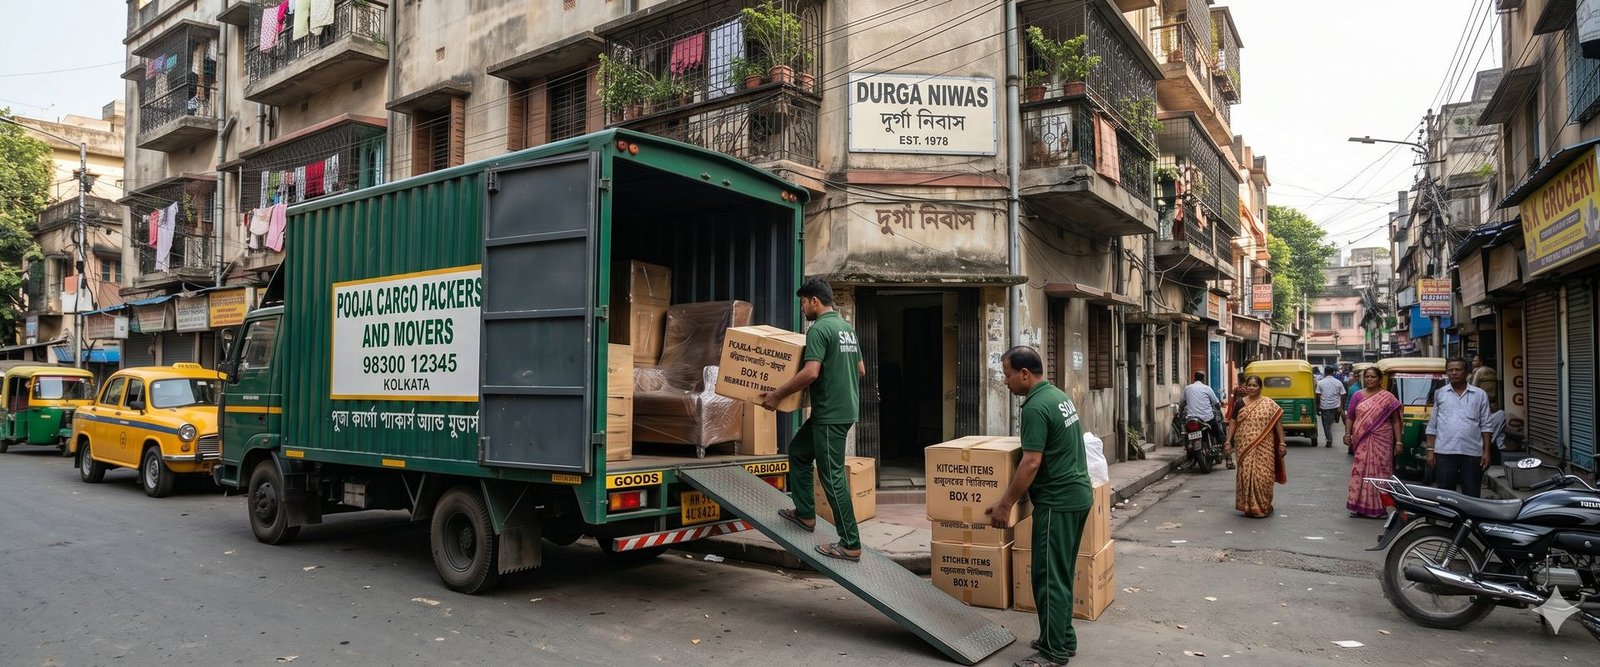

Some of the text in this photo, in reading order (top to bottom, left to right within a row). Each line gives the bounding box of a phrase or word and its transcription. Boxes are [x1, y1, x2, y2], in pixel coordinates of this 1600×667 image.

[857, 82, 988, 108] DURGA NIWAS
[879, 108, 966, 133] দুর্গা নিবাস
[899, 136, 949, 146] EST. 1978
[1541, 154, 1597, 222] GROCERY
[918, 203, 976, 231] নিবাস
[337, 277, 482, 318] POOJA CARGO PACKERS
[362, 318, 454, 348] AND MOVERS
[363, 353, 457, 374] 98300 12345
[741, 367, 757, 379] BOX
[383, 378, 430, 391] KOLKATA
[352, 405, 377, 428] কার্গো
[936, 464, 994, 476] KITCHEN ITEMS
[614, 473, 660, 487] GOODS
[949, 491, 982, 503] BOX 12
[971, 557, 991, 567] ITEMS
[953, 578, 979, 589] BOX 12
